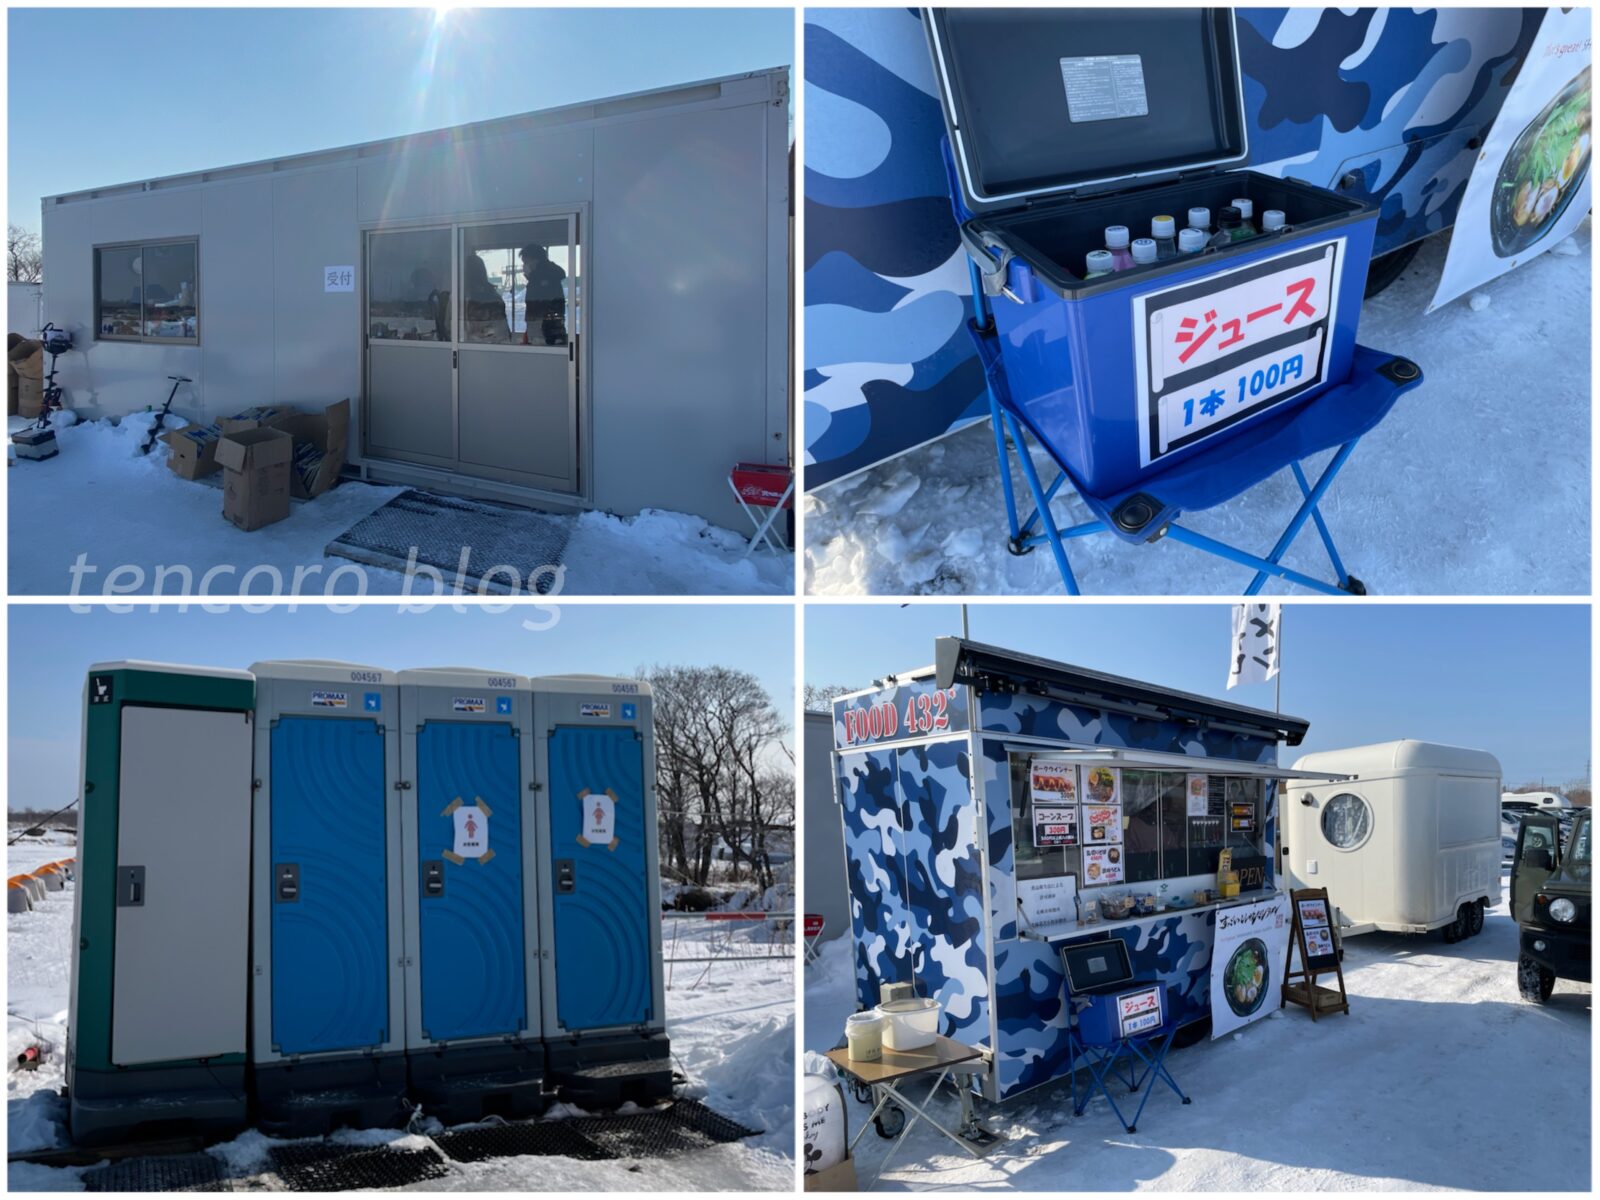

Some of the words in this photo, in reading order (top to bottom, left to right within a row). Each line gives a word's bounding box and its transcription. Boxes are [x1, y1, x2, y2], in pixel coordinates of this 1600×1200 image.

[326, 271, 352, 287] 受付
[1175, 277, 1316, 364] ジュース
[1183, 388, 1226, 427] 1本
[1238, 353, 1304, 404] 100円
[351, 671, 382, 683] 004567
[312, 691, 345, 701] PROMAX
[454, 697, 484, 706] PROMAX
[581, 702, 609, 712] PROMAX
[844, 702, 898, 743] FOOD
[1237, 866, 1265, 889] PEN
[1125, 995, 1156, 1014] ジュース
[1140, 1015, 1156, 1027] 100円
